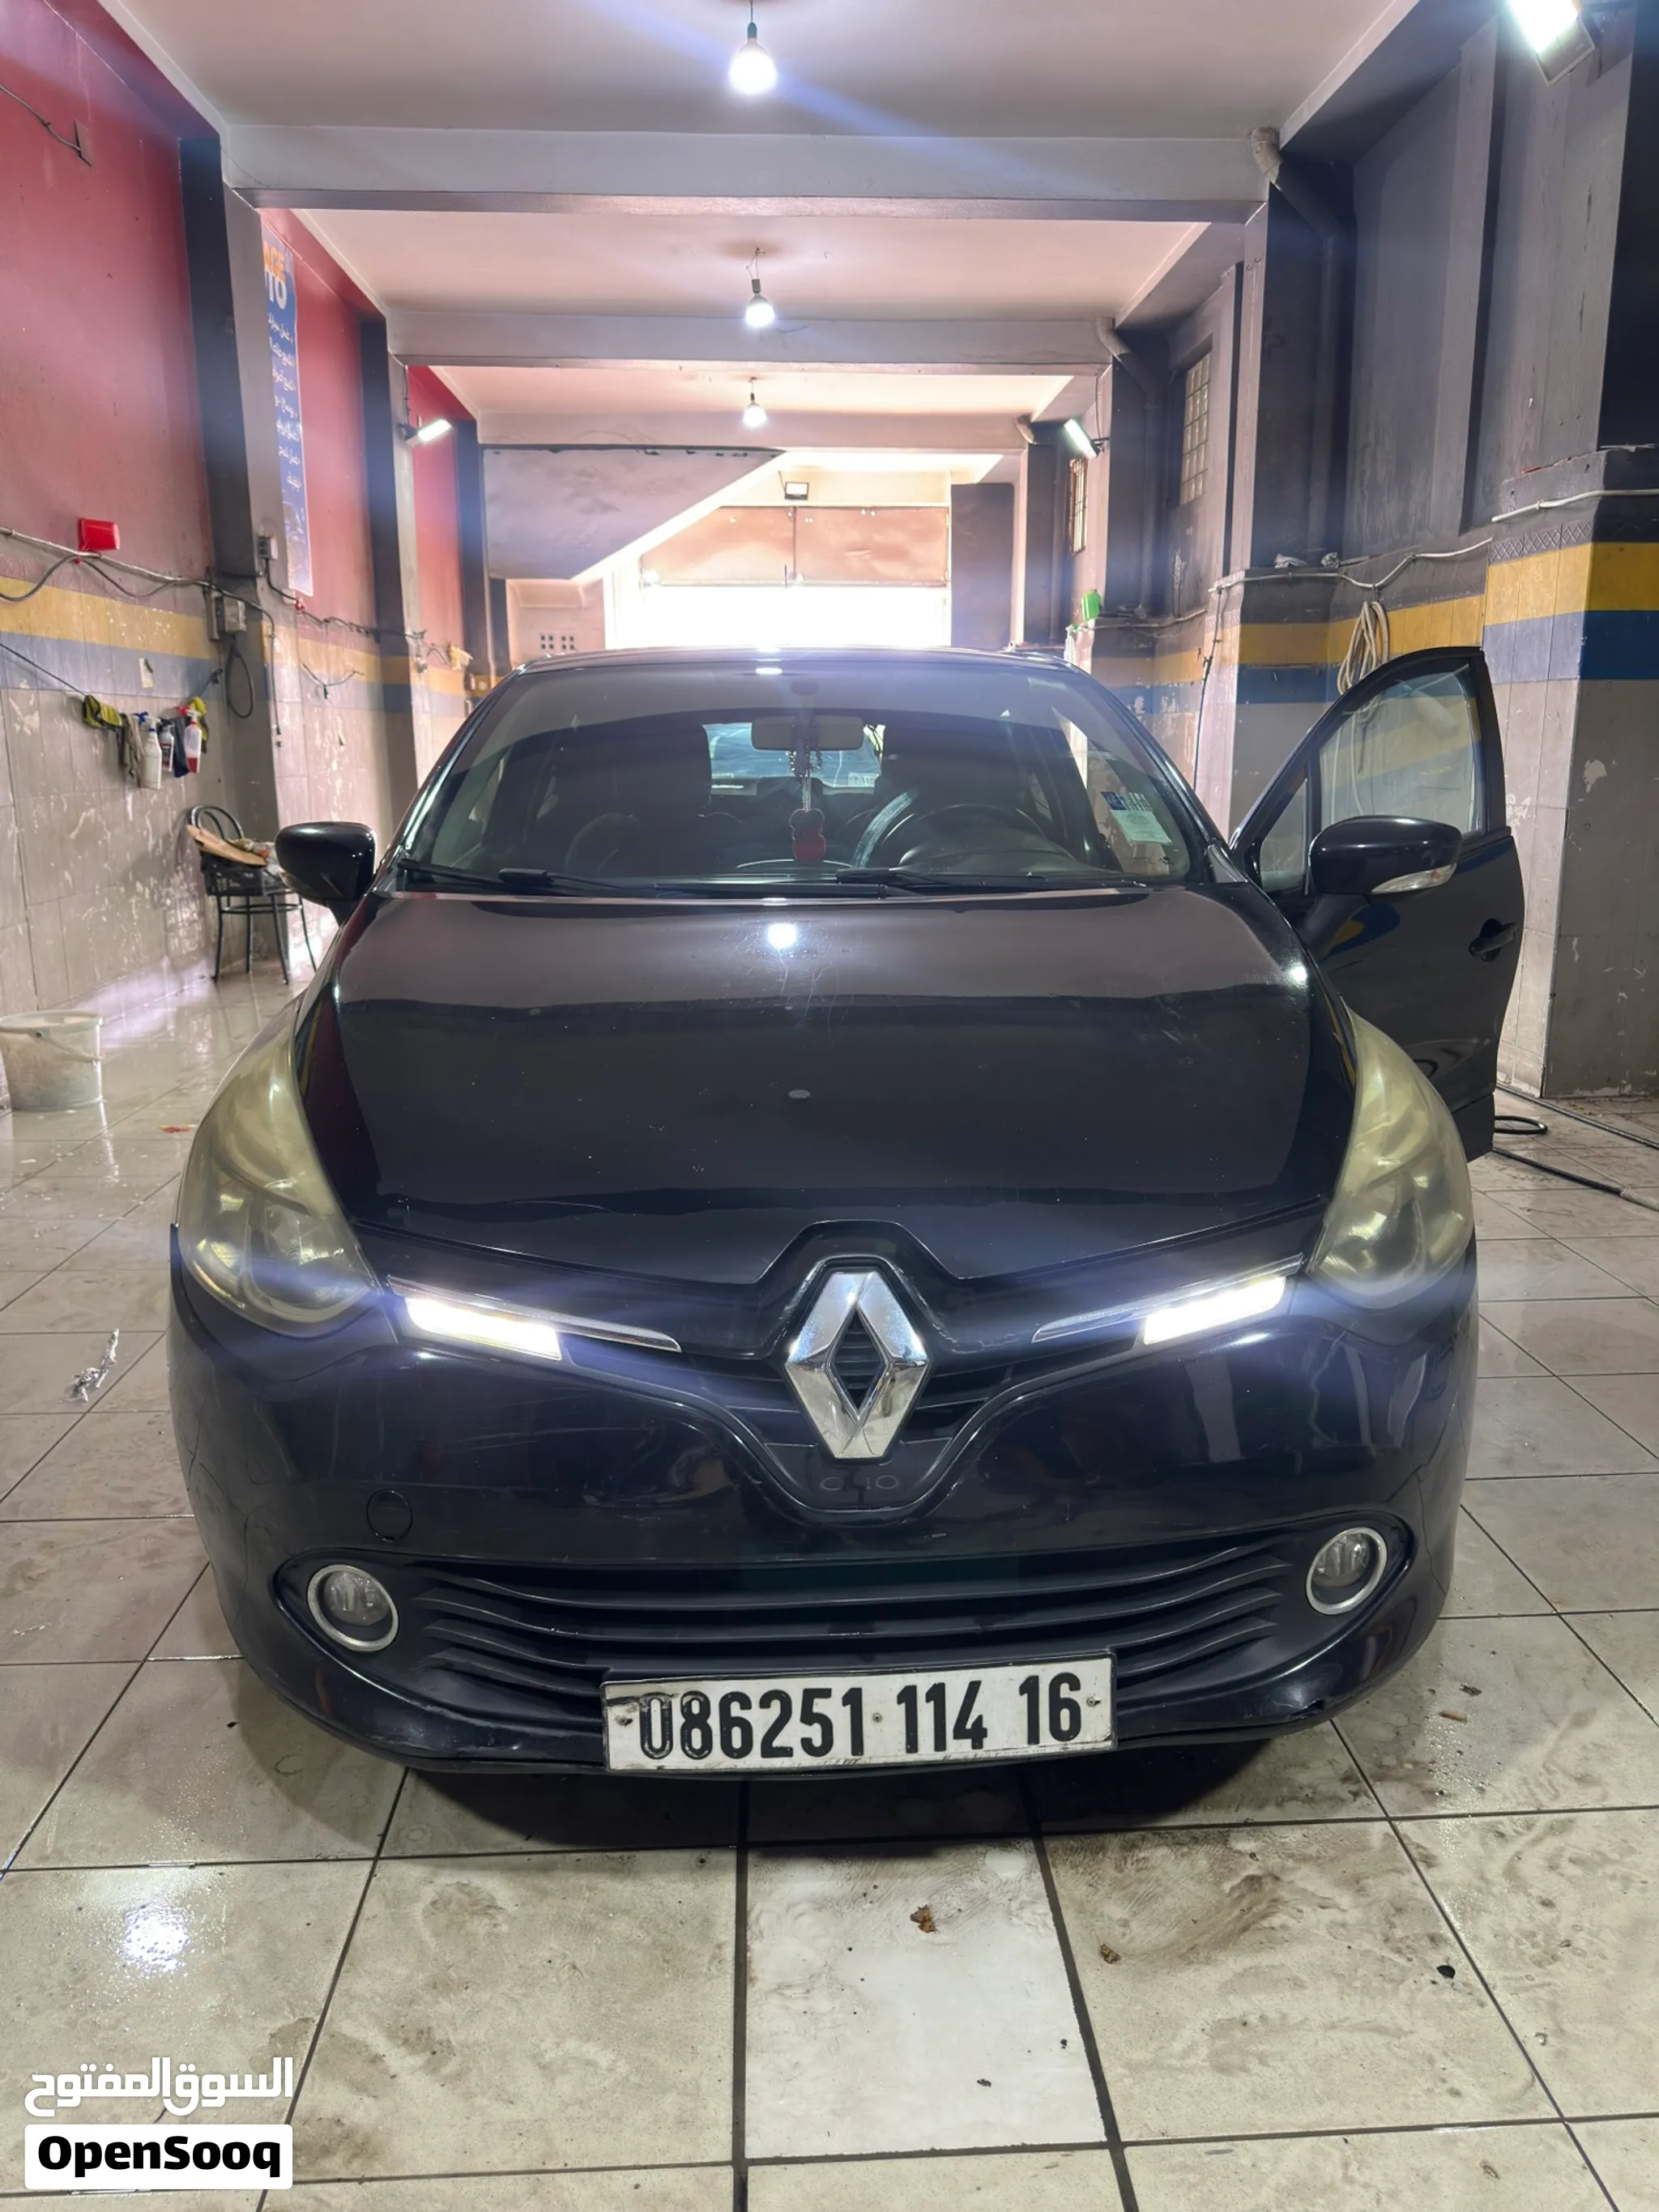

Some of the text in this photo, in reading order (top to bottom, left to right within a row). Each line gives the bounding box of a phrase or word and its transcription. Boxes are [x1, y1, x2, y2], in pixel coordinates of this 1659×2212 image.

[264, 265, 288, 309] TO
[640, 1672, 1082, 1761] 086251 114 16
